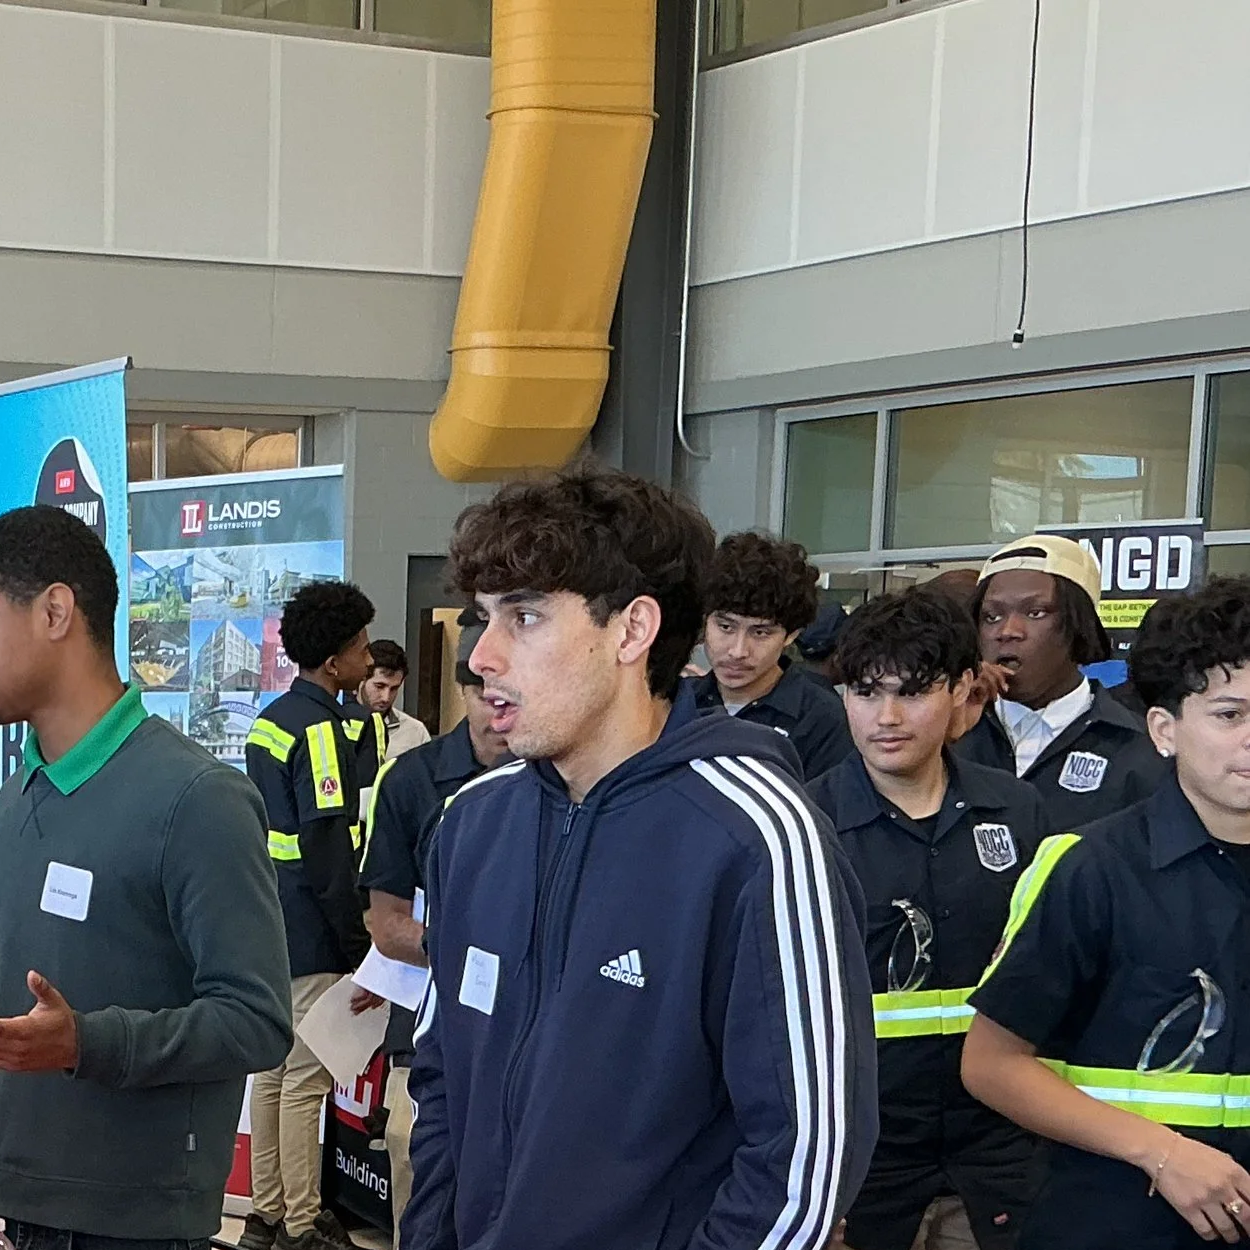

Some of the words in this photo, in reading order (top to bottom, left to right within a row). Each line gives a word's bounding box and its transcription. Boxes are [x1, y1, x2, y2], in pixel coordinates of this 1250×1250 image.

[208, 500, 282, 522] LANDIS
[207, 521, 263, 531] CONSTRUCTION
[599, 965, 645, 988] adidas
[335, 1147, 389, 1201] Building
